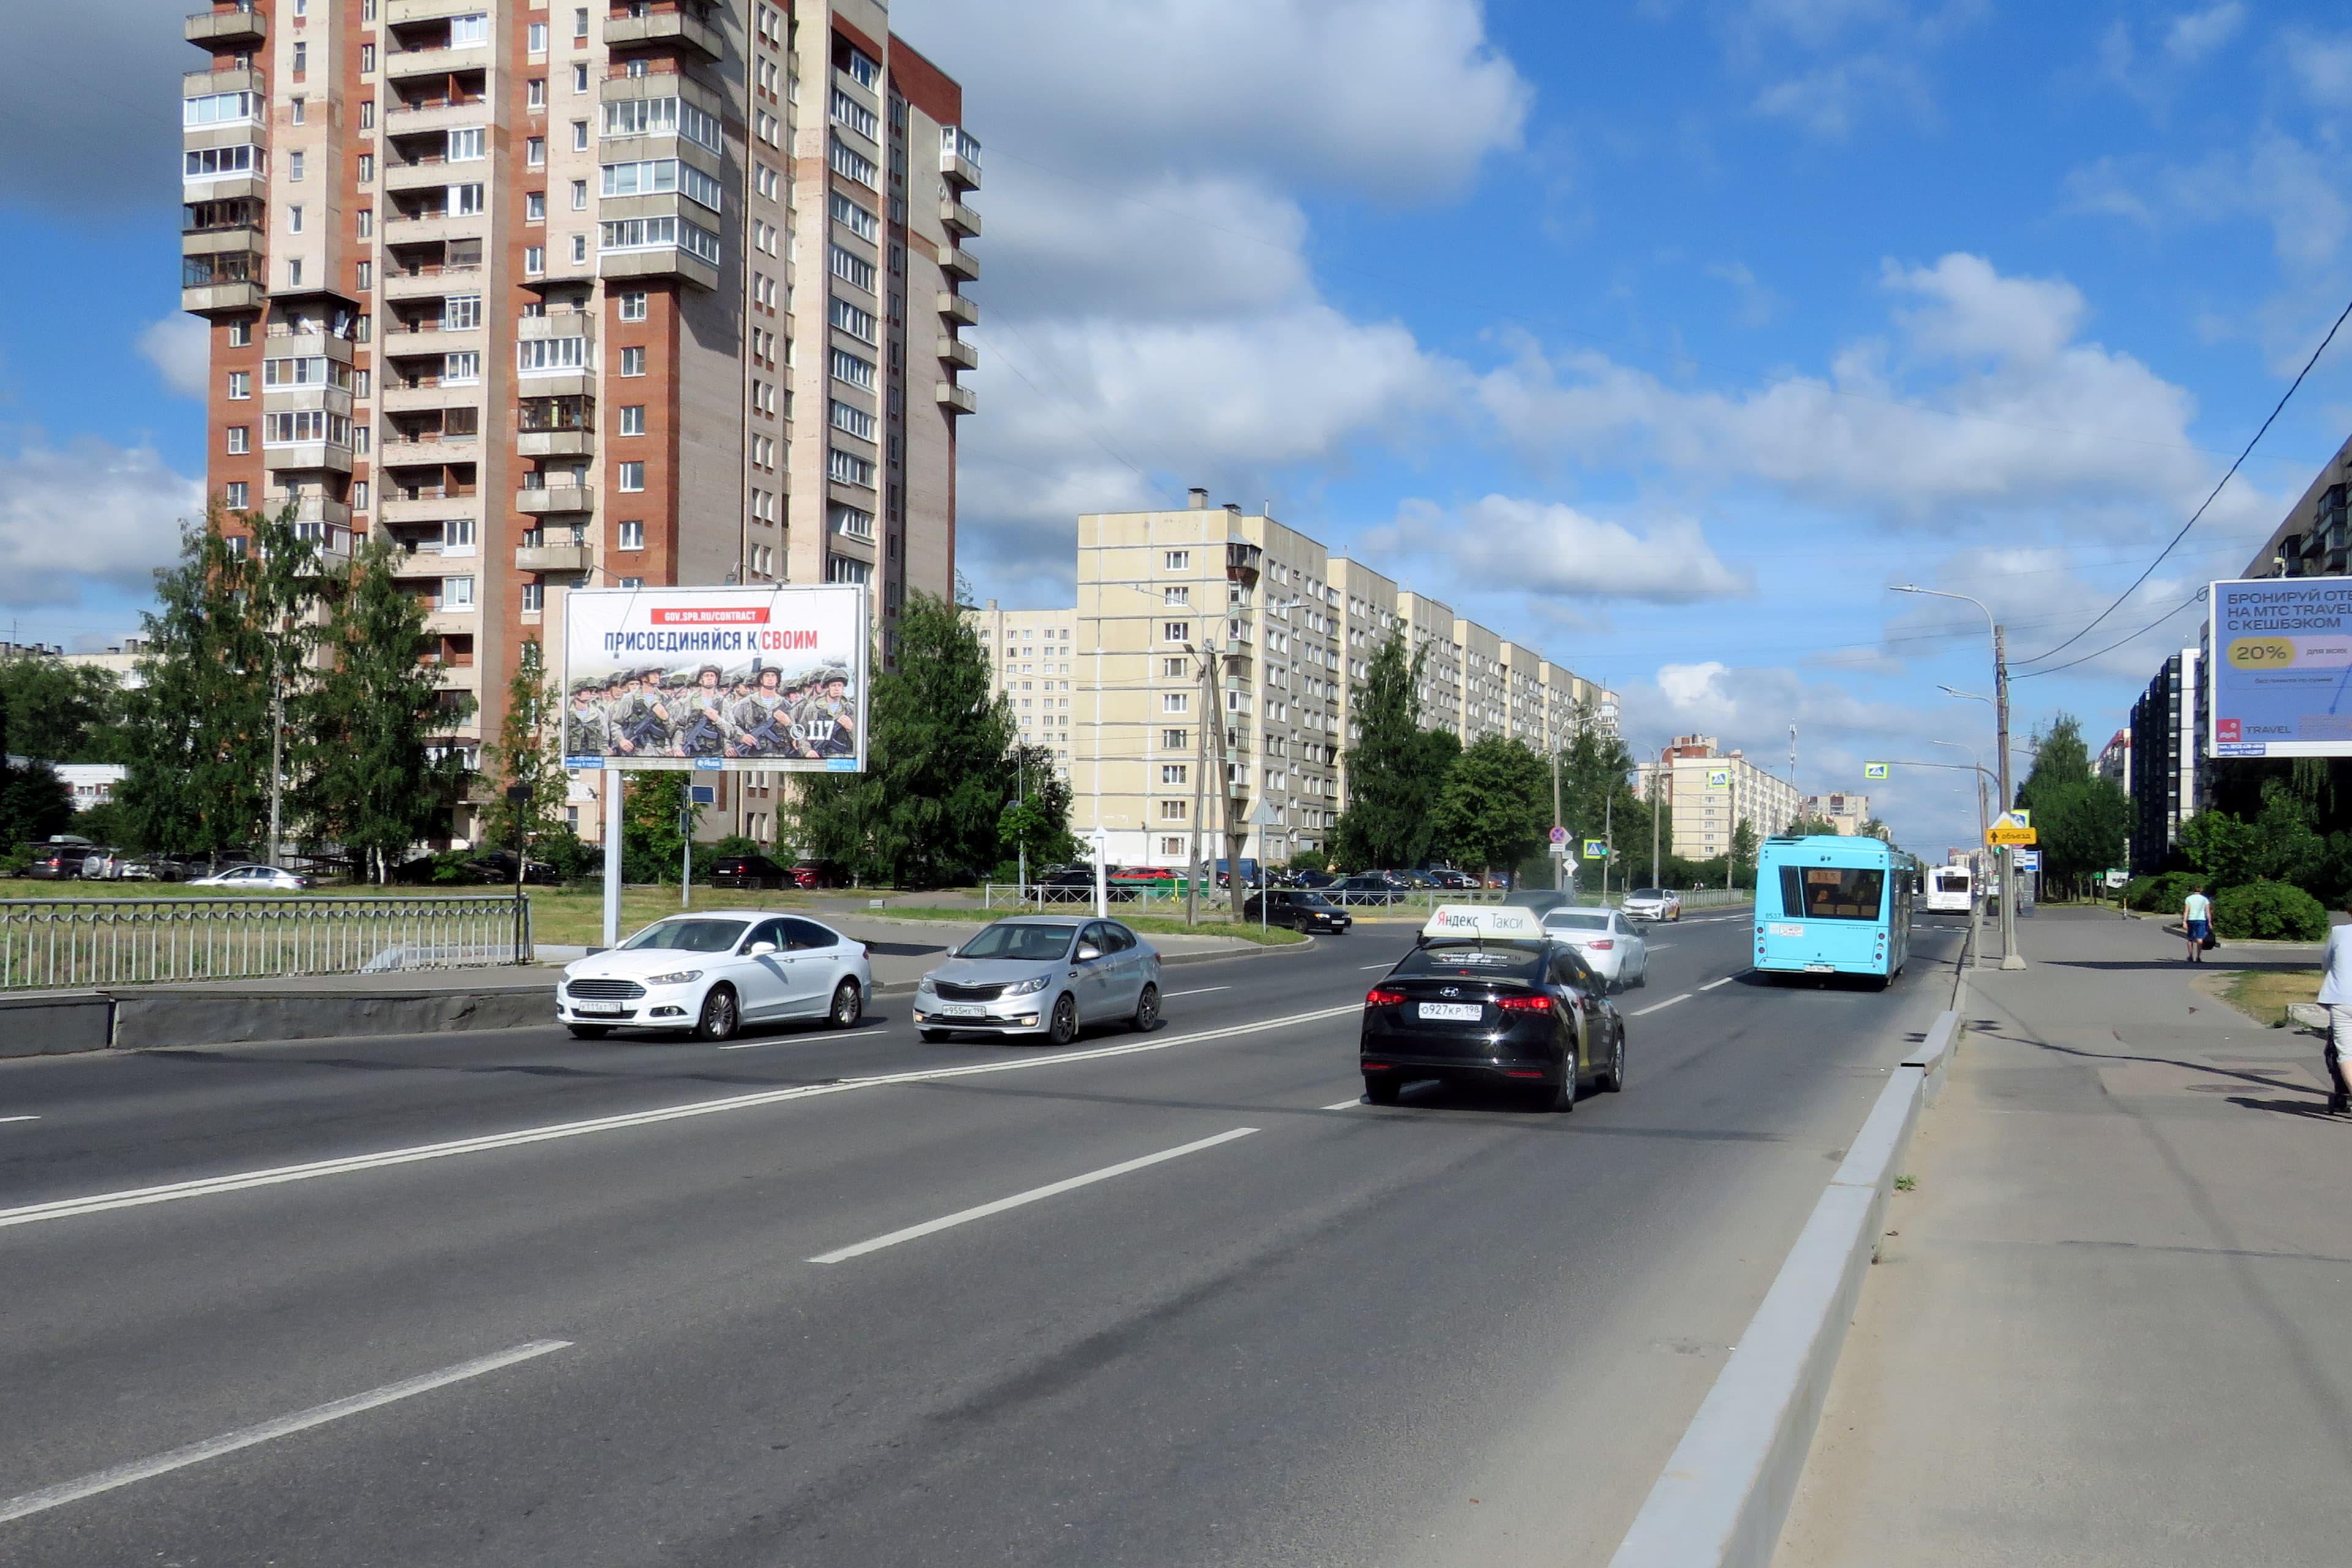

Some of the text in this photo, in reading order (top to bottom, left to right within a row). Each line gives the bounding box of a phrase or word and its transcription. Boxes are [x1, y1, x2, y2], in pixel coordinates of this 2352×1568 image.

[2228, 589, 2320, 605] БРОНИРУЙ
[665, 611, 756, 622] GOV.SPB.RU/CONTRACT
[2228, 606, 2250, 617] НА
[2254, 605, 2290, 616] МТС
[2227, 617, 2341, 631] С КЕШБЭКОМ
[605, 627, 818, 652] ПРИСОЕДИНЯЙСЯ К СВОИМ
[2237, 646, 2286, 660] 20%
[807, 720, 835, 741] 117
[2245, 725, 2292, 734] TRAVEL
[1437, 911, 1523, 929] Яндекс Такси
